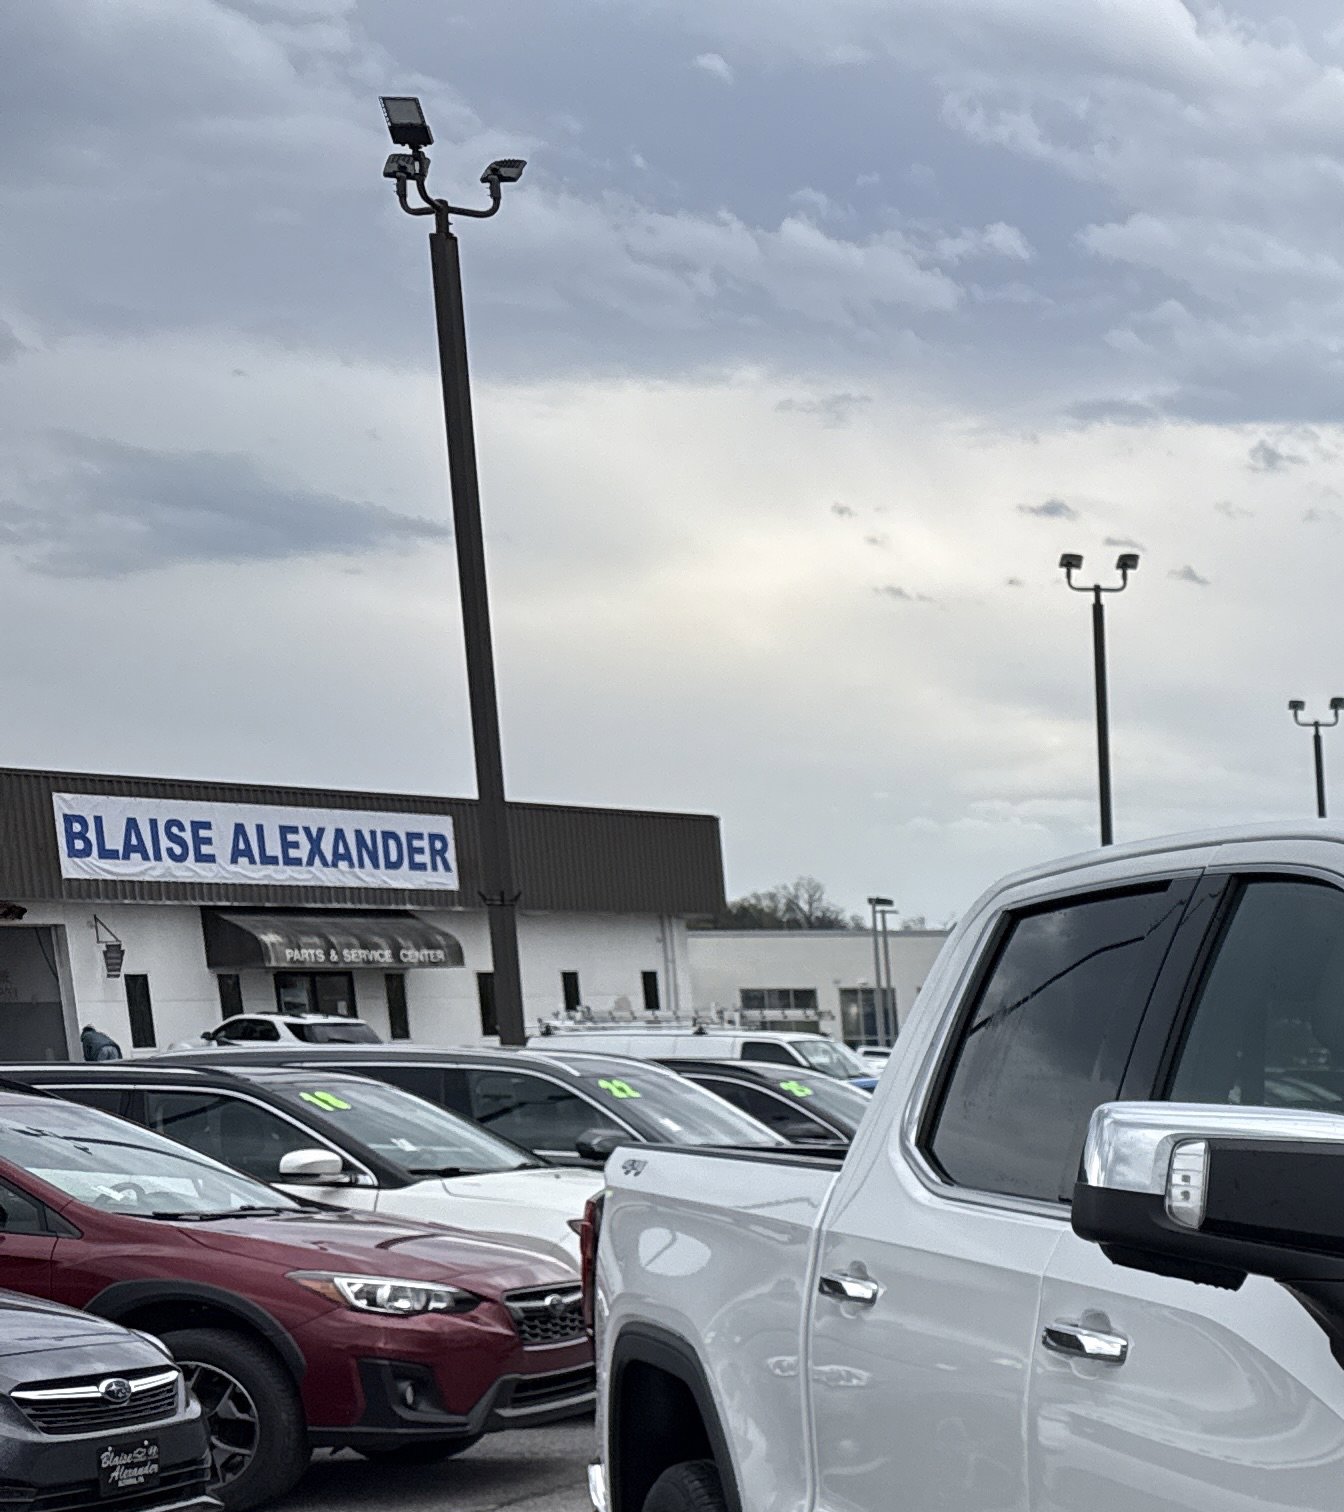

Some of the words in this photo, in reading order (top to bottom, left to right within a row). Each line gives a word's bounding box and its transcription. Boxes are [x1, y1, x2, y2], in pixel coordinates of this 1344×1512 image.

[62, 813, 217, 864] BLAISE
[230, 822, 453, 873] ALEXANDER
[286, 948, 326, 962] PARTS
[330, 949, 339, 962] &
[343, 949, 393, 963] SERVICE
[400, 949, 444, 963] CENTER
